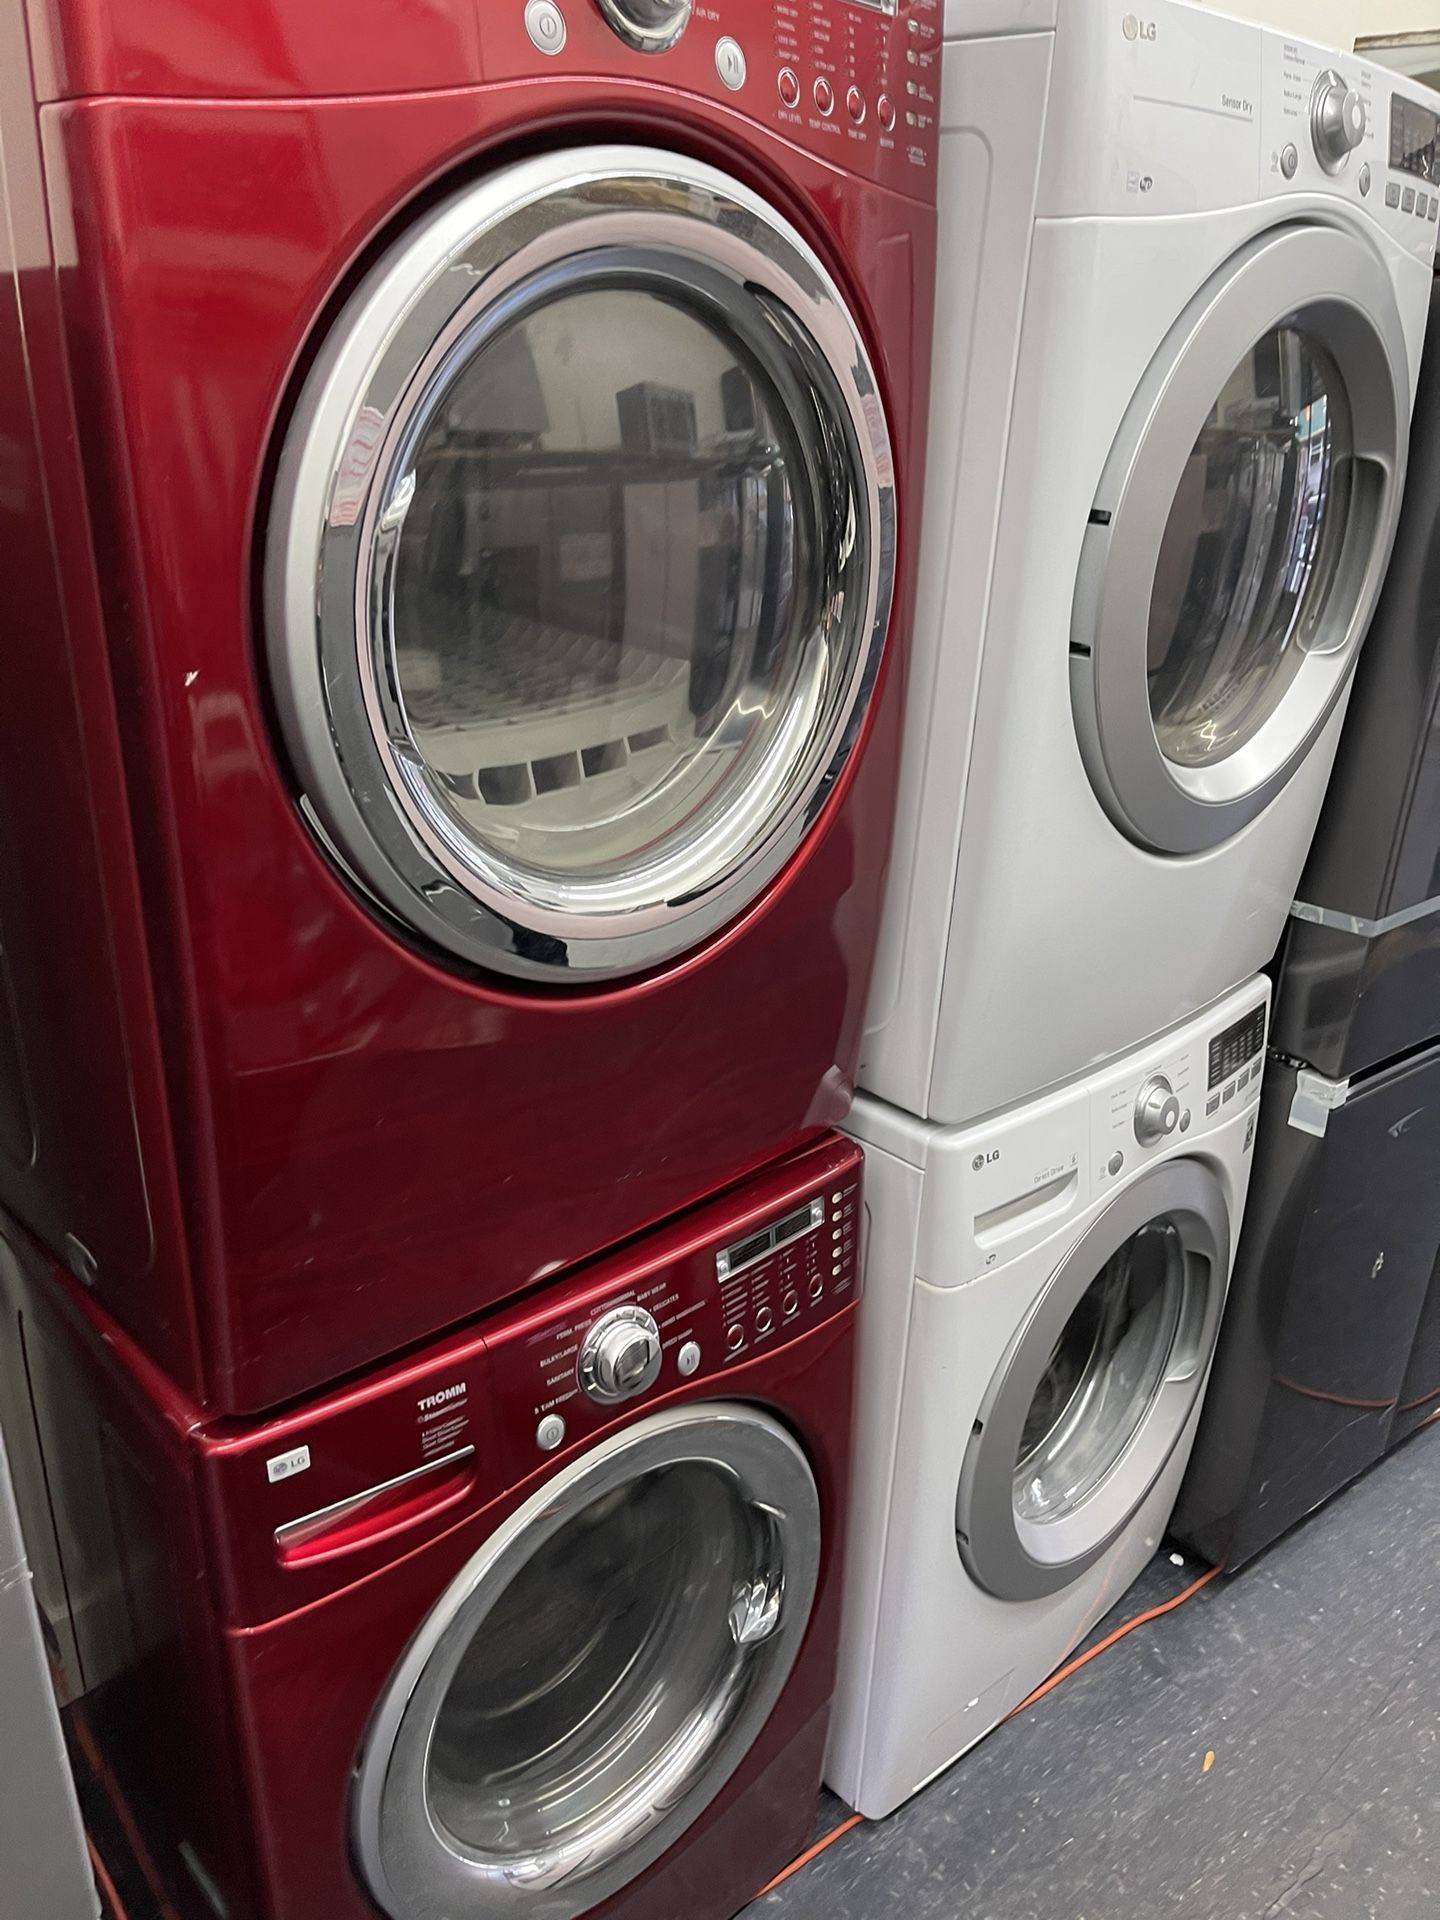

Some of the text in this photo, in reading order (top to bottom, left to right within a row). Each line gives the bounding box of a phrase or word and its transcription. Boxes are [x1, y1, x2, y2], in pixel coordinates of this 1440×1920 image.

[1140, 21, 1156, 41] LG
[1242, 99, 1253, 115] Dry
[986, 1150, 999, 1163] LG
[417, 1382, 467, 1411] TROMM
[291, 1455, 305, 1468] LG
